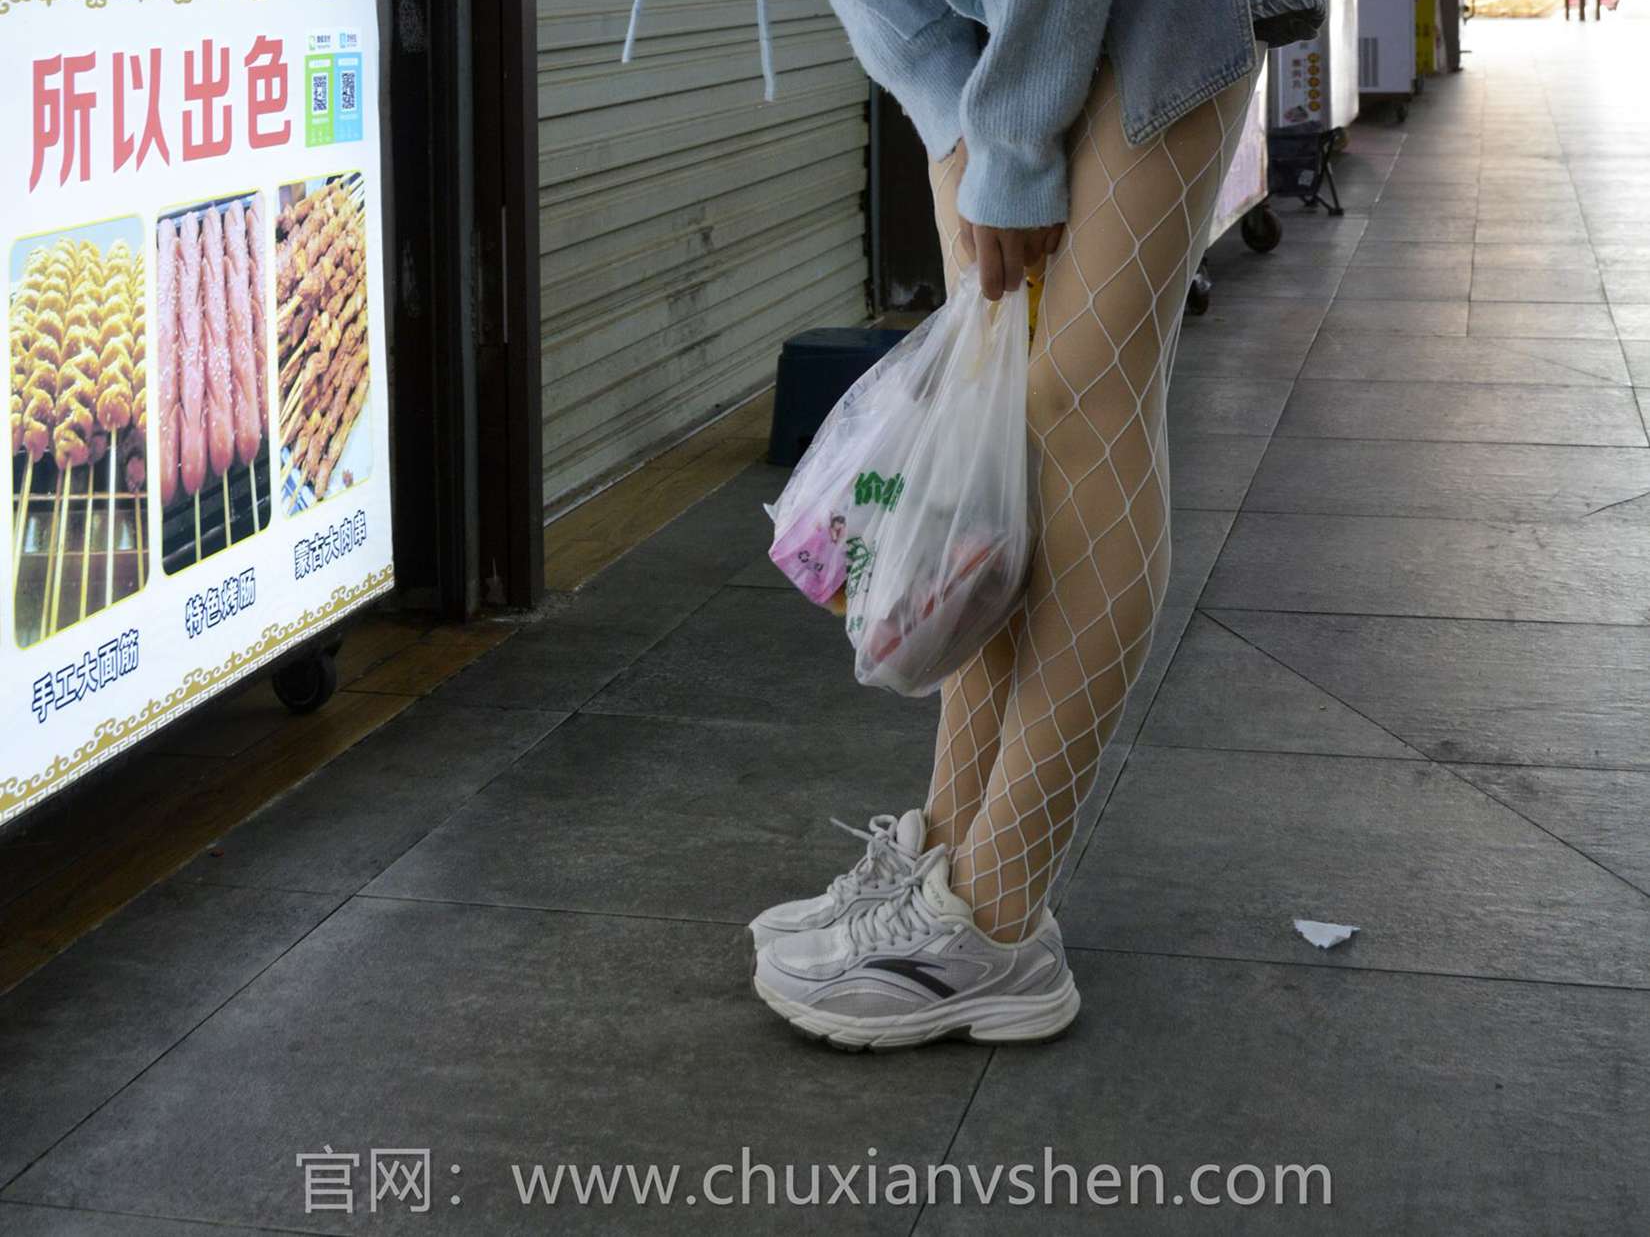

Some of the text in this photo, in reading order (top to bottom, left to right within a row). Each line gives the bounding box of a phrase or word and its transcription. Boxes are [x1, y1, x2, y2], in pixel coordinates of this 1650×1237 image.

[29, 35, 291, 194] 所以出色
[294, 510, 367, 580] 蒙古大肉串
[185, 568, 256, 638] 特色烤肠
[32, 629, 139, 724] 手工大面筋
